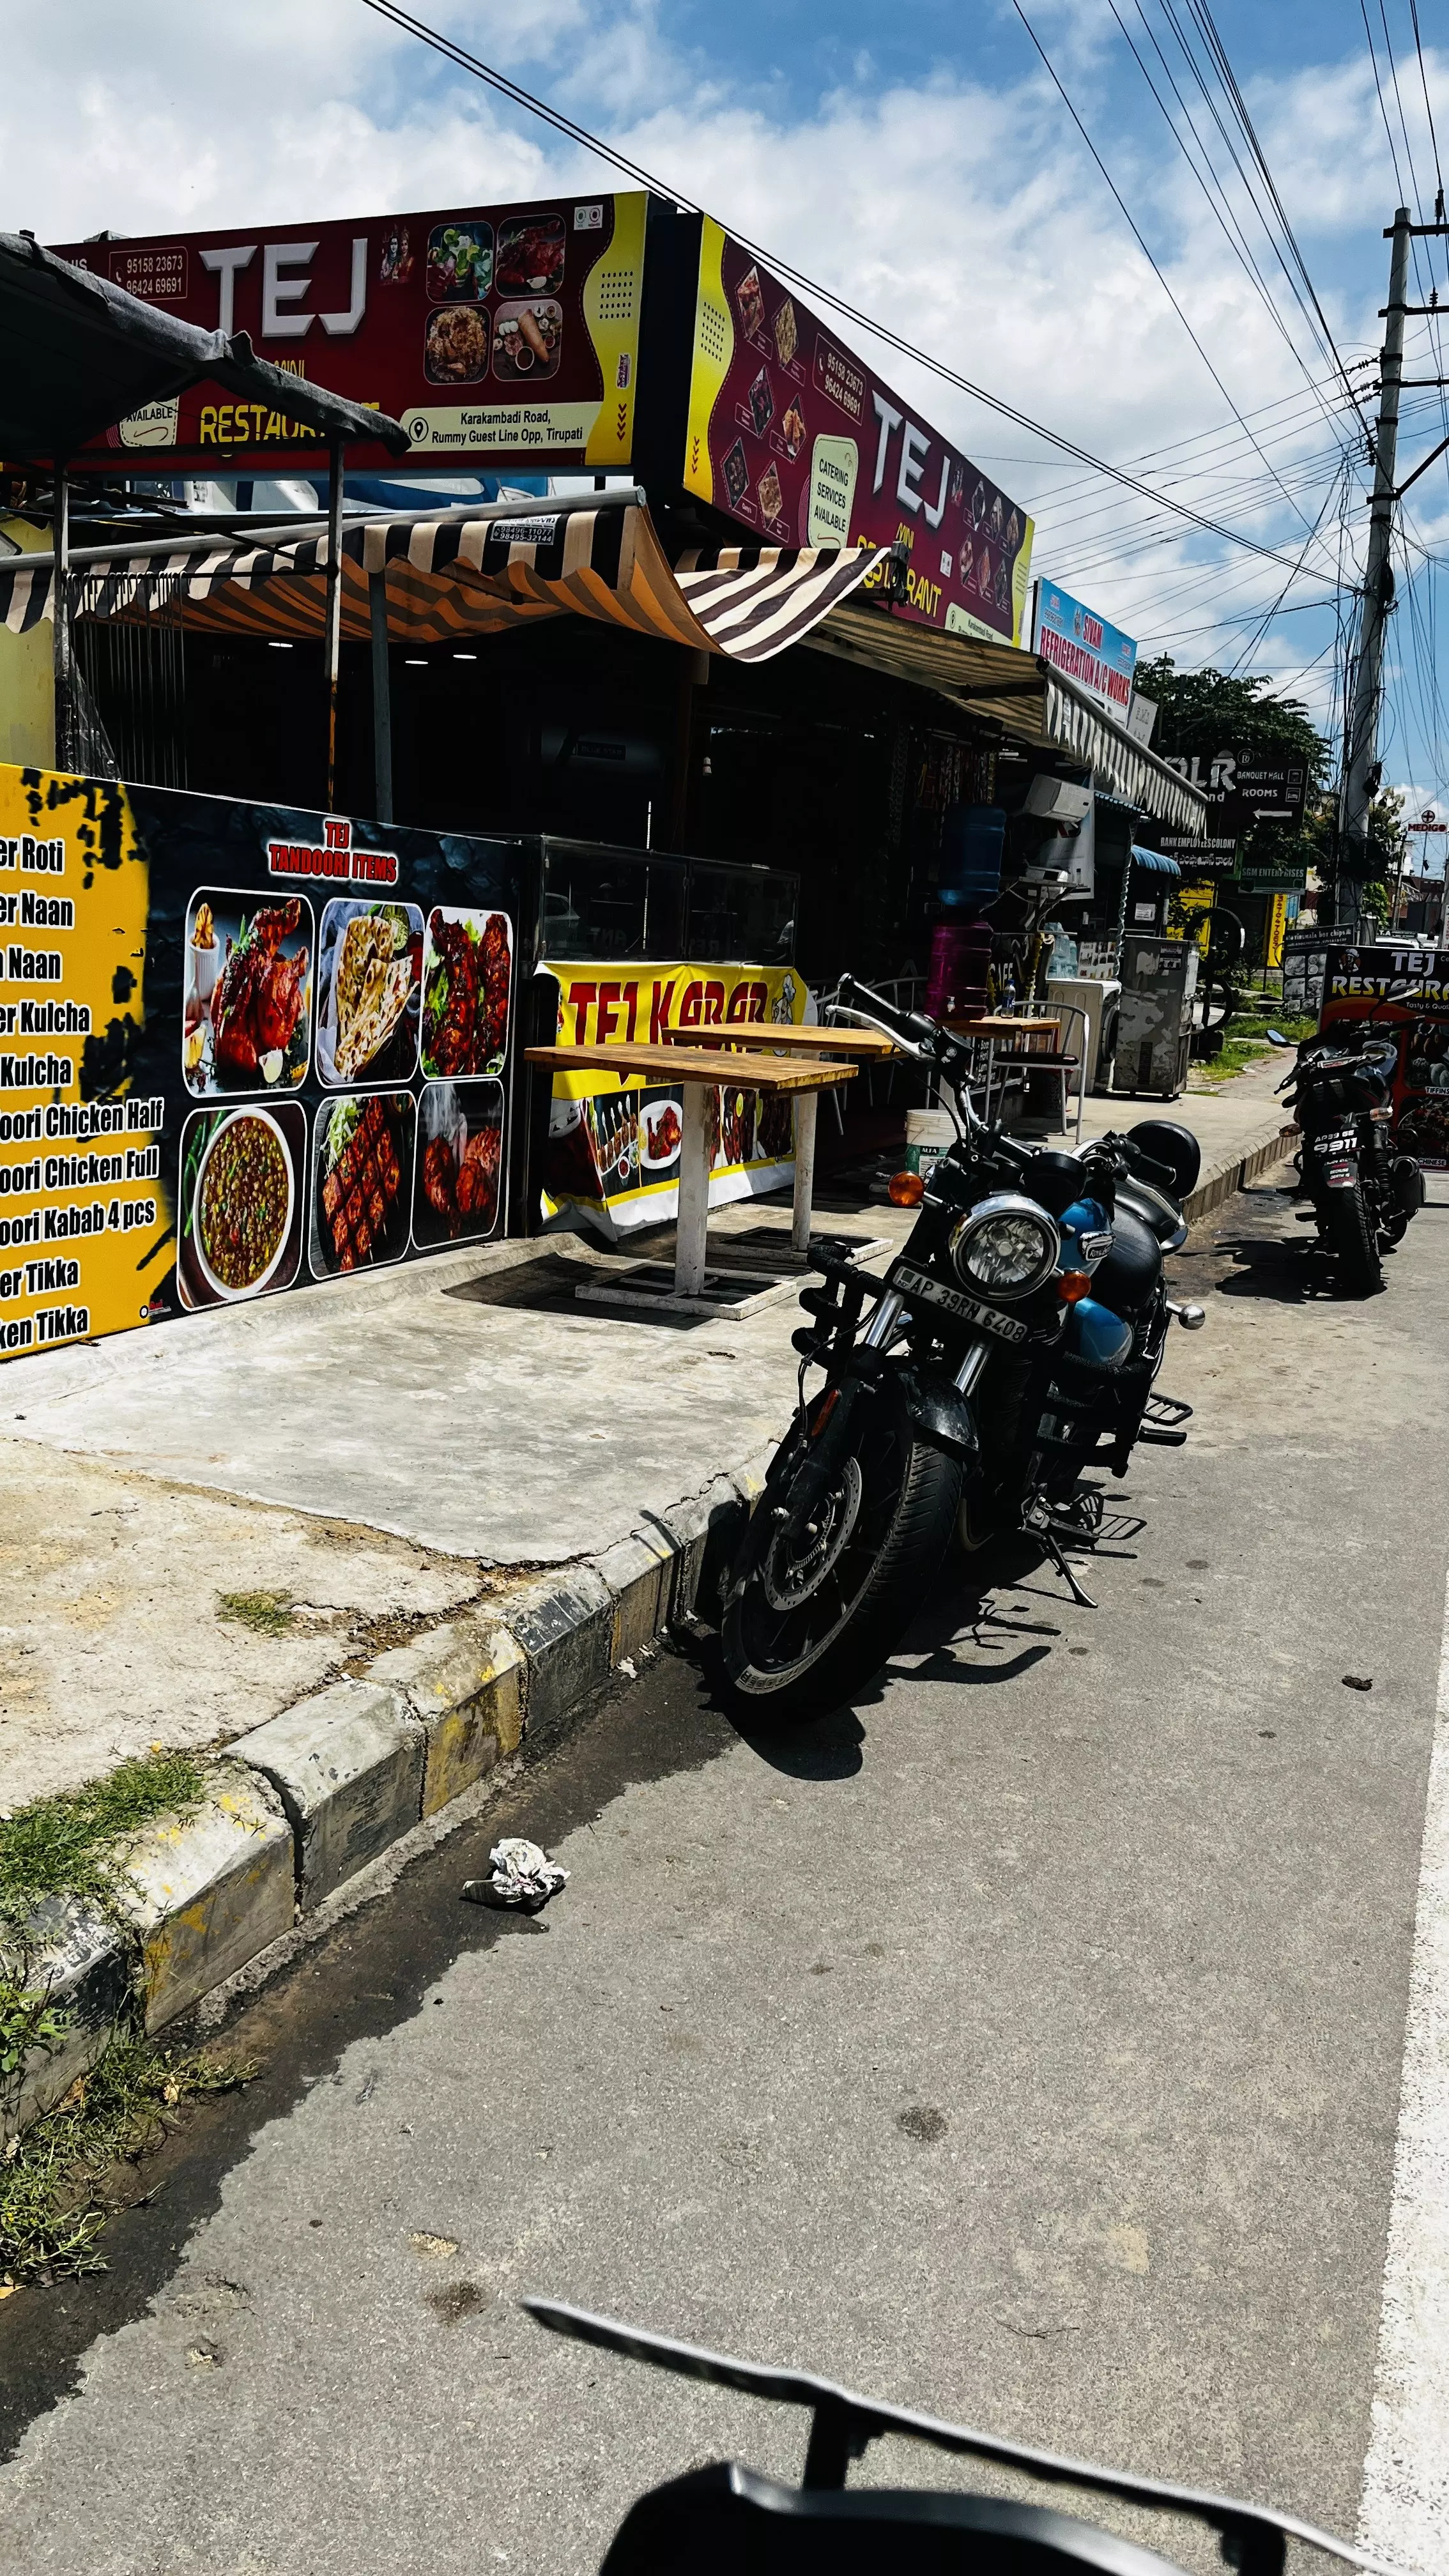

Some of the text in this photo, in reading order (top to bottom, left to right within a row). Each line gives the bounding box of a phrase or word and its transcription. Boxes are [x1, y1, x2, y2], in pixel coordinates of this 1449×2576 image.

[127, 256, 183, 273] 95158 23673
[127, 277, 181, 295] 96424 69691
[199, 238, 367, 340] TEJ
[827, 353, 845, 380] 95158
[846, 370, 863, 395] 23673
[825, 374, 861, 416] 96424 69691
[128, 408, 172, 422] AVAILABLE
[461, 410, 551, 425] Karakambadi Road,
[432, 427, 583, 445] Rummy Guest Line Opp, Tirupati
[819, 458, 848, 487] CATERING
[872, 390, 950, 528] TEJ
[817, 482, 846, 509] SERVICES
[501, 526, 551, 535] 98496-11077
[814, 505, 847, 532] AVAILABLE
[500, 533, 551, 542] 98495-32144
[896, 523, 914, 549] MINI
[1083, 613, 1103, 652] SIVAM
[1040, 625, 1096, 685] REFRIGERATION
[1107, 668, 1130, 707] WORKS
[1237, 771, 1284, 780] BANQUET HALL
[1242, 788, 1278, 797] ROOMS
[325, 821, 349, 848] TEJ
[1160, 837, 1177, 847] BANK
[1211, 838, 1236, 848] COLONY
[22, 837, 63, 871] Roti
[269, 844, 397, 882] TANDOORI ITEMS
[1259, 868, 1304, 878] ENTERPRISES
[22, 893, 73, 926] Naan
[9, 947, 60, 979] Naan
[1391, 952, 1435, 977] TEJ
[20, 1002, 90, 1032] Kulcha
[1, 1055, 72, 1087] Kulcha
[46, 1104, 123, 1137] Chicken
[128, 1100, 163, 1130] Half
[1314, 1137, 1358, 1153] 9911
[45, 1154, 121, 1188] Chicken
[126, 1149, 158, 1179] Full
[45, 1204, 103, 1239] Kabab
[108, 1202, 119, 1229] 4
[124, 1200, 155, 1230] pcs
[26, 1260, 78, 1292] Tikka
[910, 1277, 933, 1296] AP
[36, 1308, 88, 1342] Tikka
